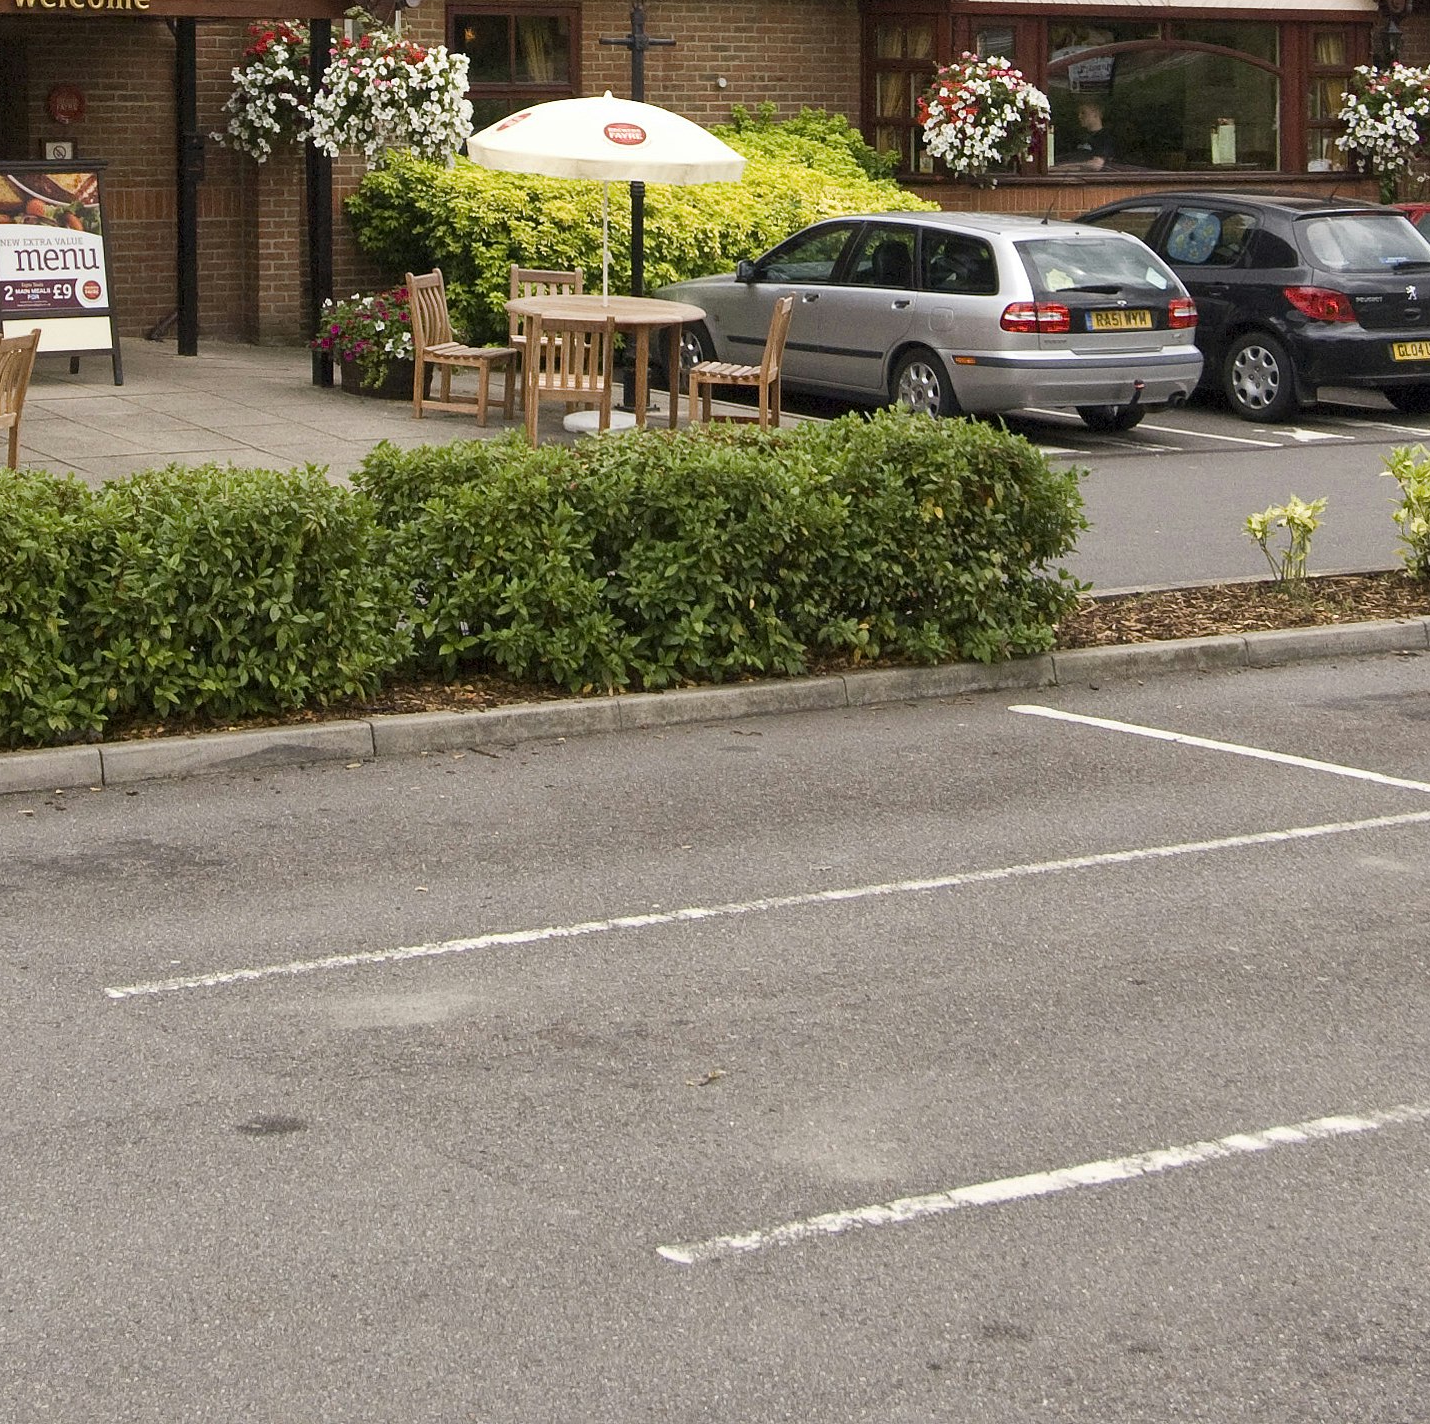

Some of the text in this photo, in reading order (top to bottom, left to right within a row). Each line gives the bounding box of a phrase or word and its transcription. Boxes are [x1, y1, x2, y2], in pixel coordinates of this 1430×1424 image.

[0, 237, 83, 247] NEW EXTRA VALUE
[14, 248, 100, 272] menu
[4, 285, 14, 301] 2
[53, 284, 72, 299] £9
[1095, 312, 1123, 326] RA51
[1398, 344, 1424, 357] GL04
